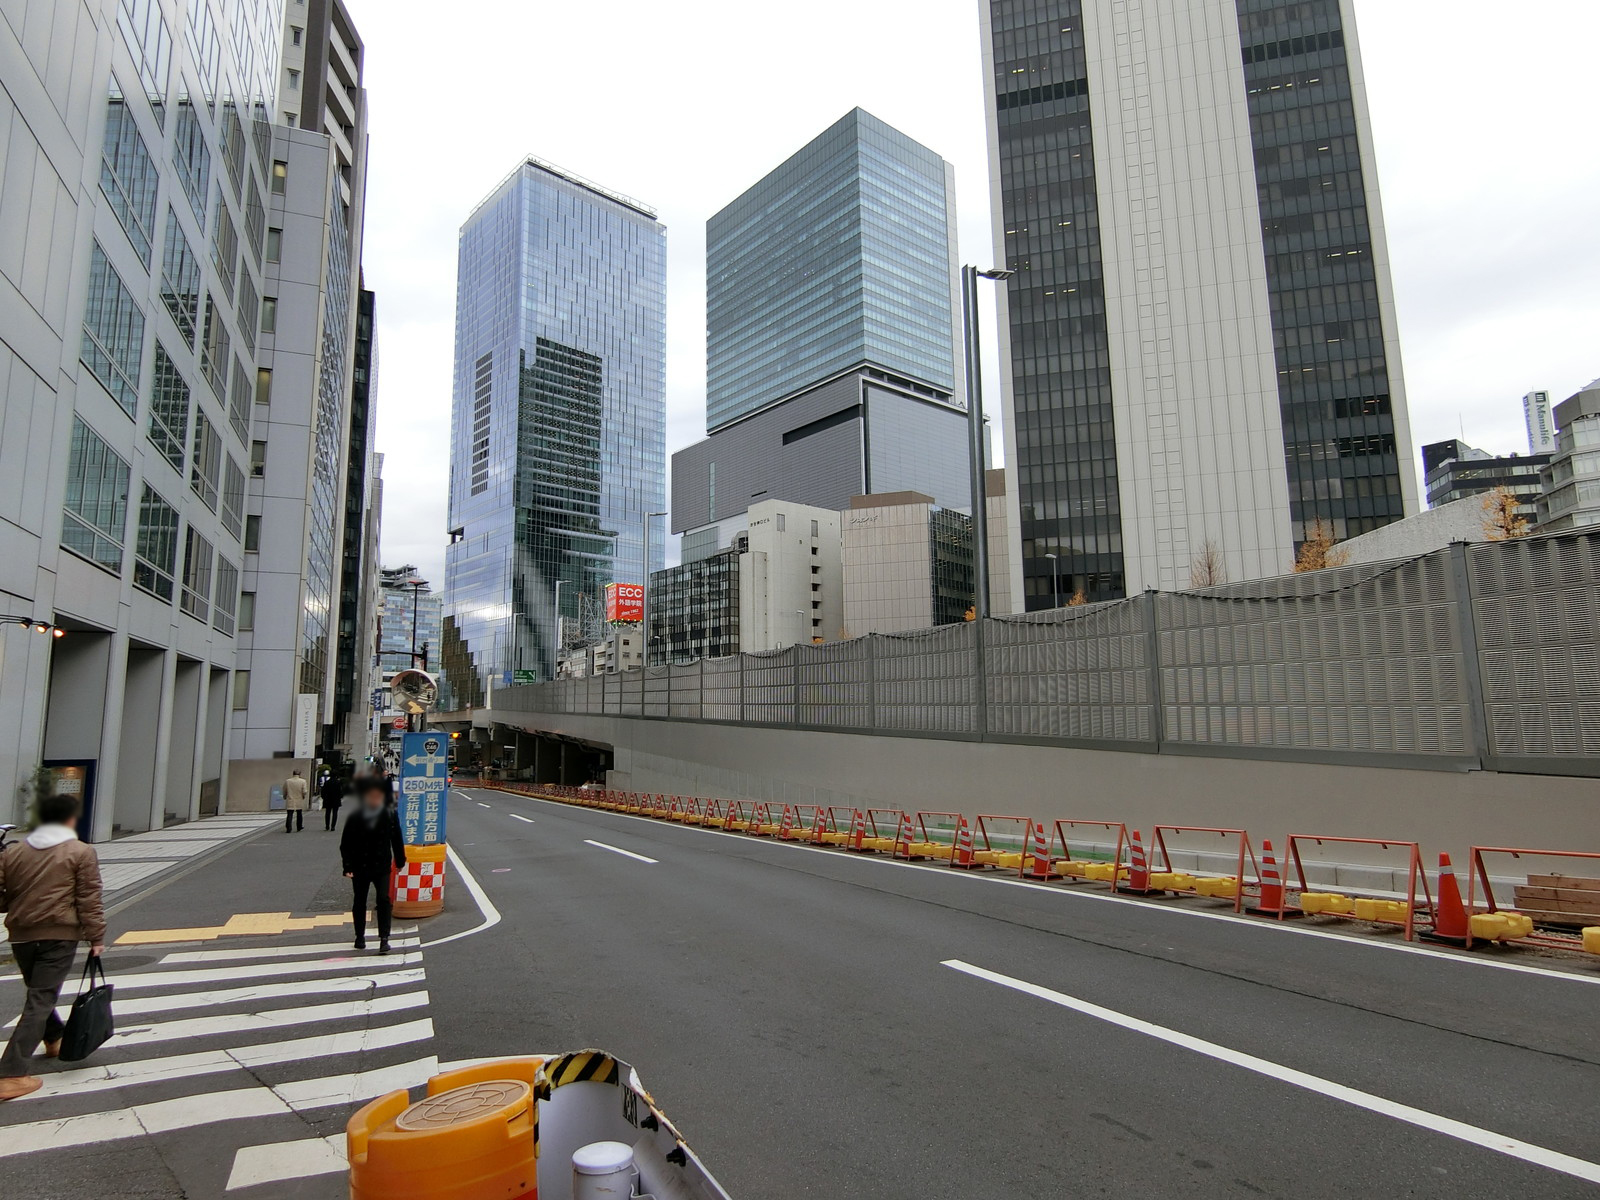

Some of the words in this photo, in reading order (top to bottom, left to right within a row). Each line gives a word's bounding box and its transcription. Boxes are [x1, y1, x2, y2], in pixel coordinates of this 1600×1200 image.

[1536, 404, 1550, 445] Manulife
[618, 587, 643, 598] ECC
[618, 599, 642, 607] 外語学院
[405, 780, 443, 790] 250M先
[406, 793, 420, 844] 左折願います
[424, 793, 439, 842] 恵比寿方面
